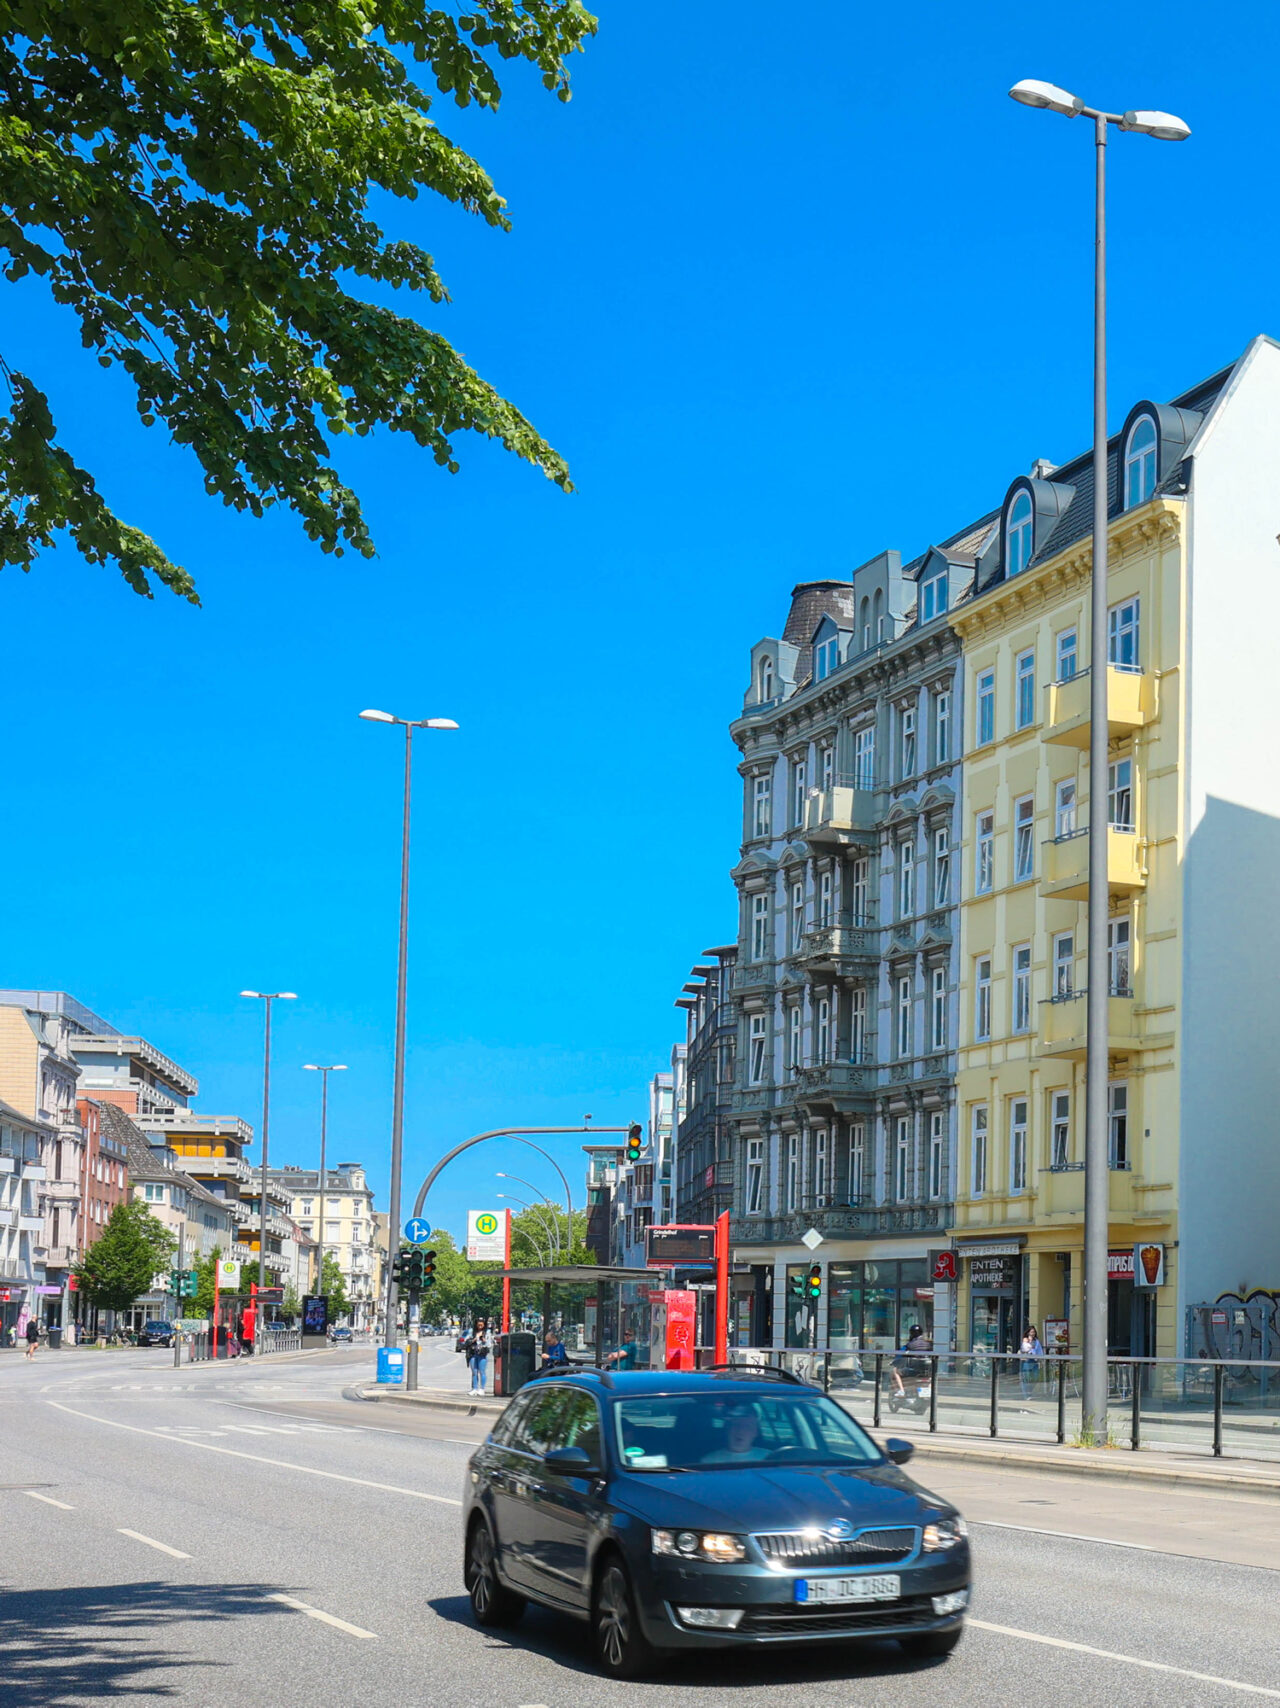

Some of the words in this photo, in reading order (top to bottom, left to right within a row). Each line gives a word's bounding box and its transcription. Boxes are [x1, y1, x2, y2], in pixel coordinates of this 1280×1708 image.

[482, 1218, 492, 1230] H
[971, 1259, 1004, 1270] ENTEN
[971, 1272, 1004, 1283] APOTHEKE
